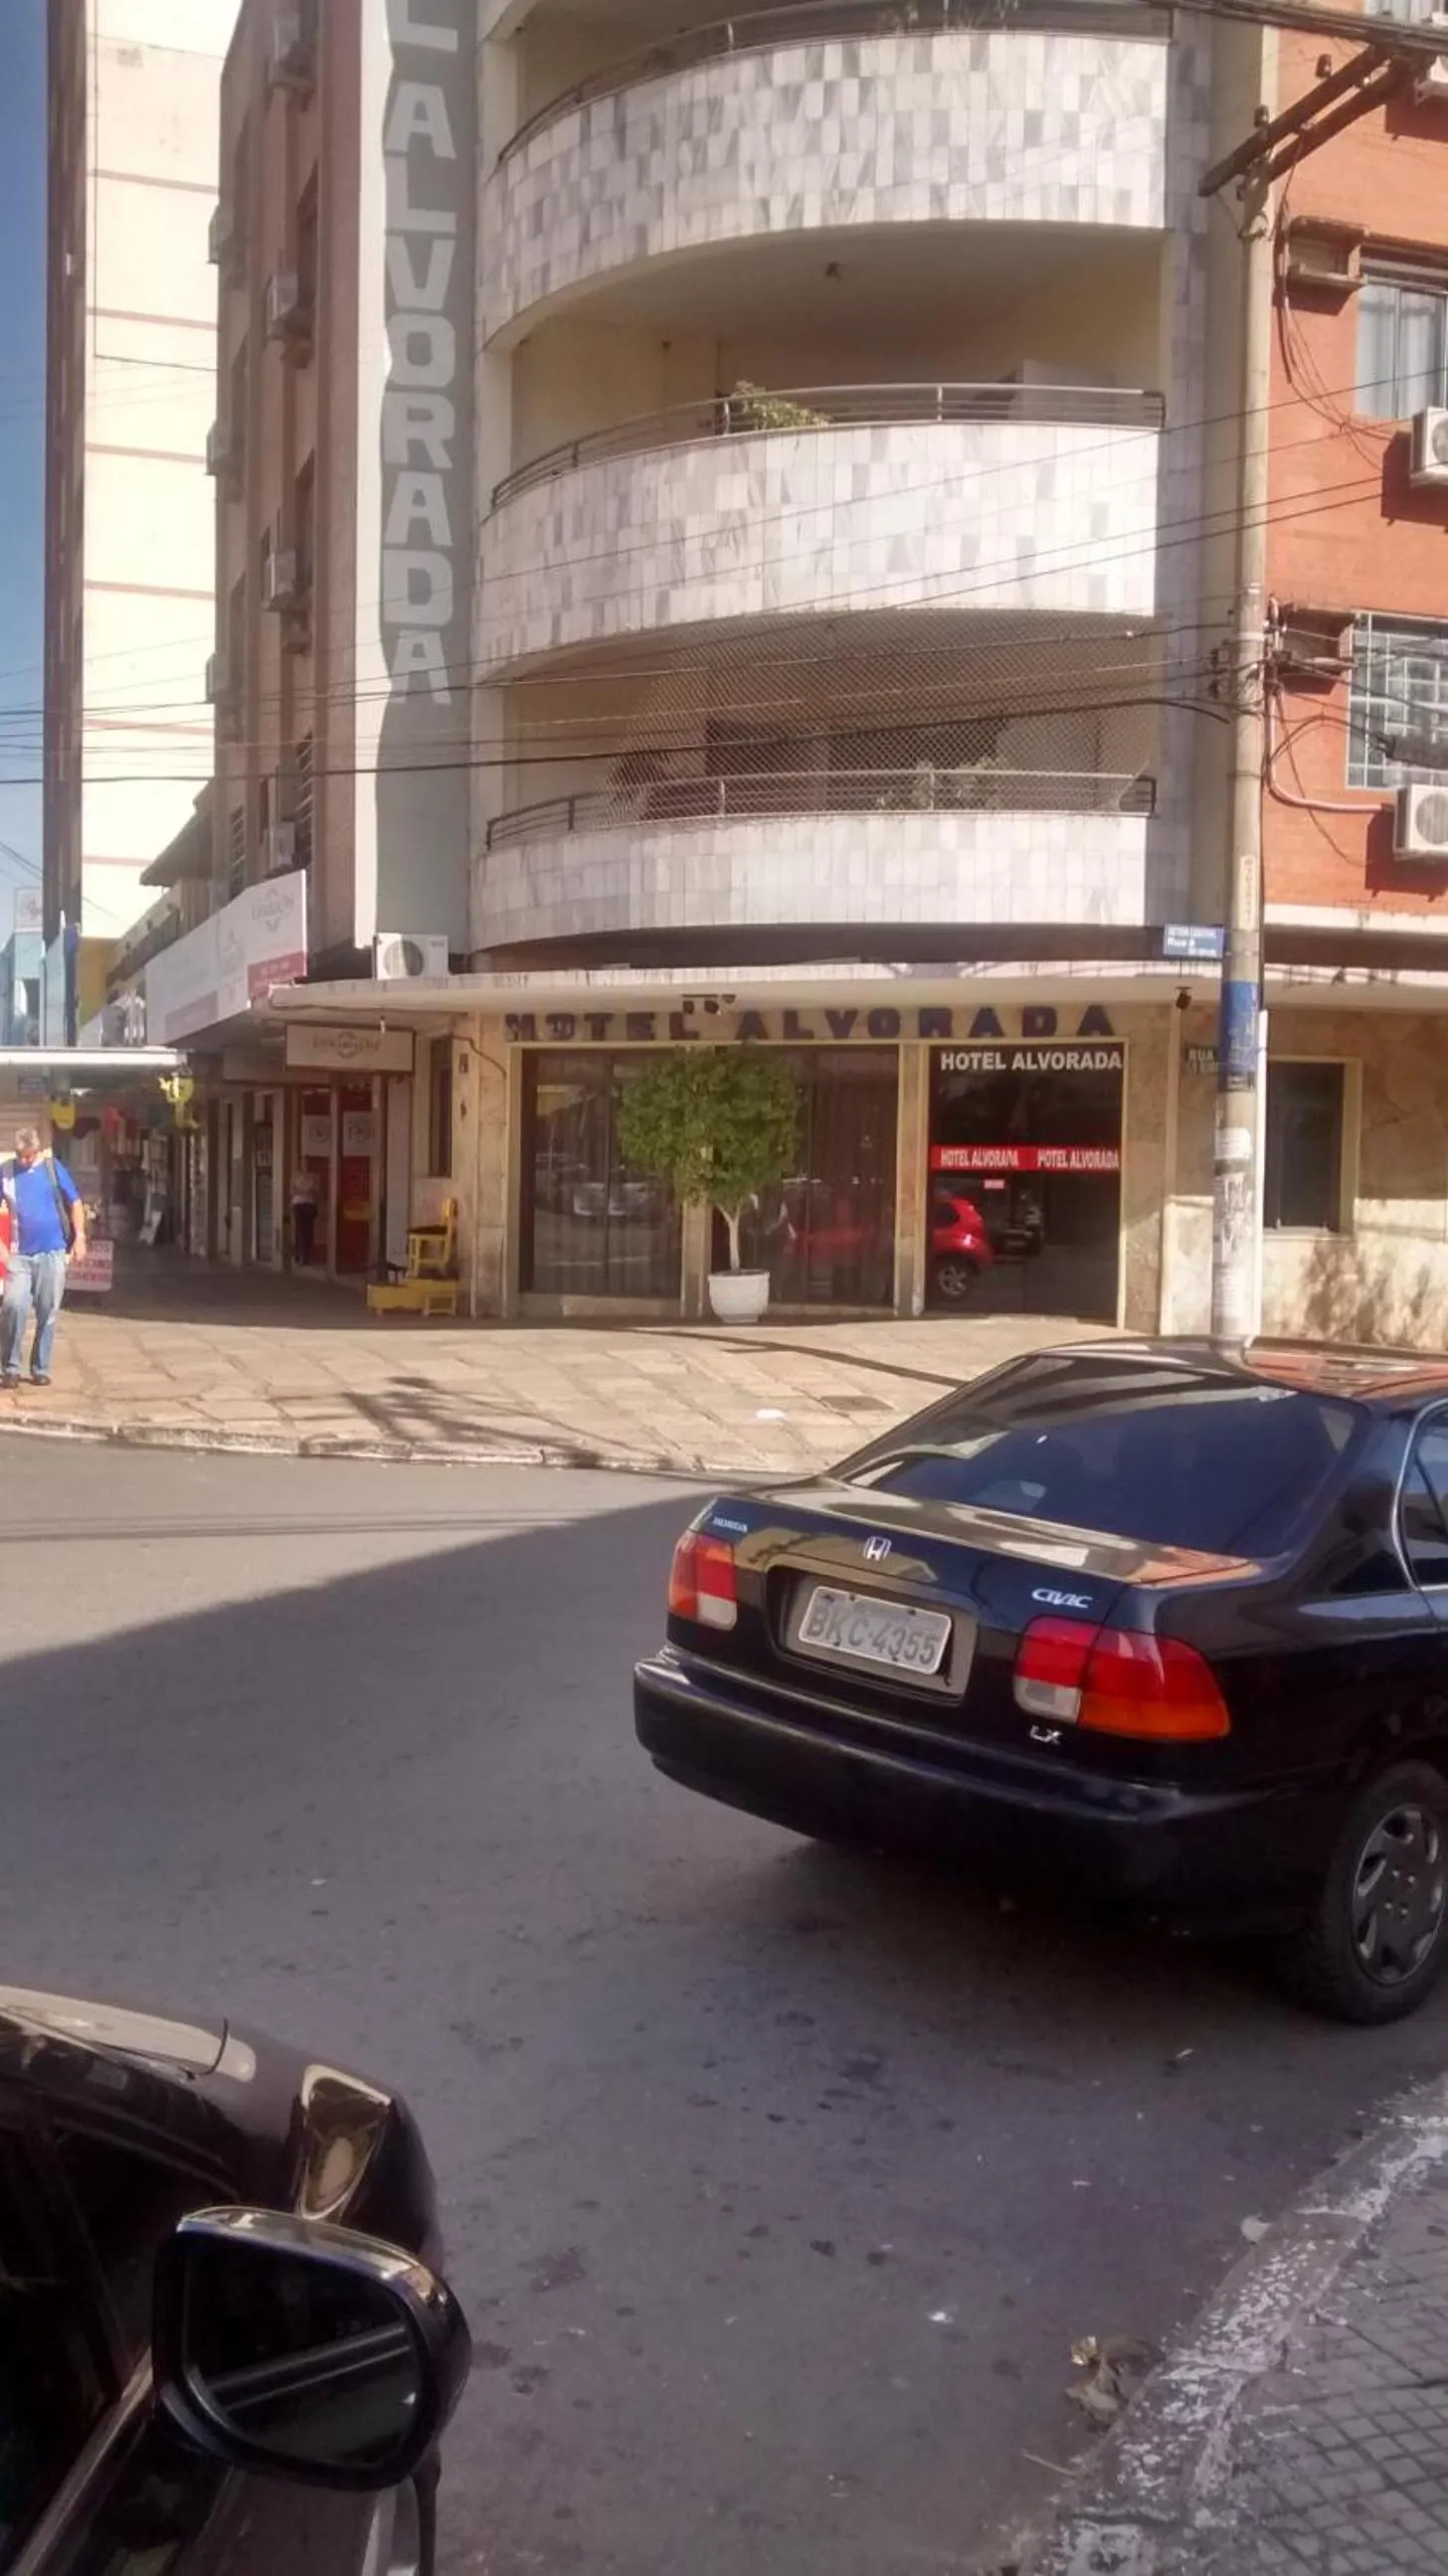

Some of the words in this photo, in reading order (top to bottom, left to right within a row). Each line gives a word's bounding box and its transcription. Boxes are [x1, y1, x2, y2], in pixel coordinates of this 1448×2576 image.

[382, 83, 457, 705] ALVORADA
[734, 1004, 1116, 1040] ALVORADA
[940, 1051, 1006, 1071] HOTEL
[1011, 1051, 1123, 1071] ALVORADA
[940, 1149, 969, 1168] HOTEL
[971, 1149, 1019, 1168] ALVORADA
[1037, 1149, 1068, 1168] HOTEL
[1069, 1149, 1120, 1168] ALVORADA
[1031, 1588, 1093, 1609] CIVIC
[1029, 1724, 1062, 1745] LX
